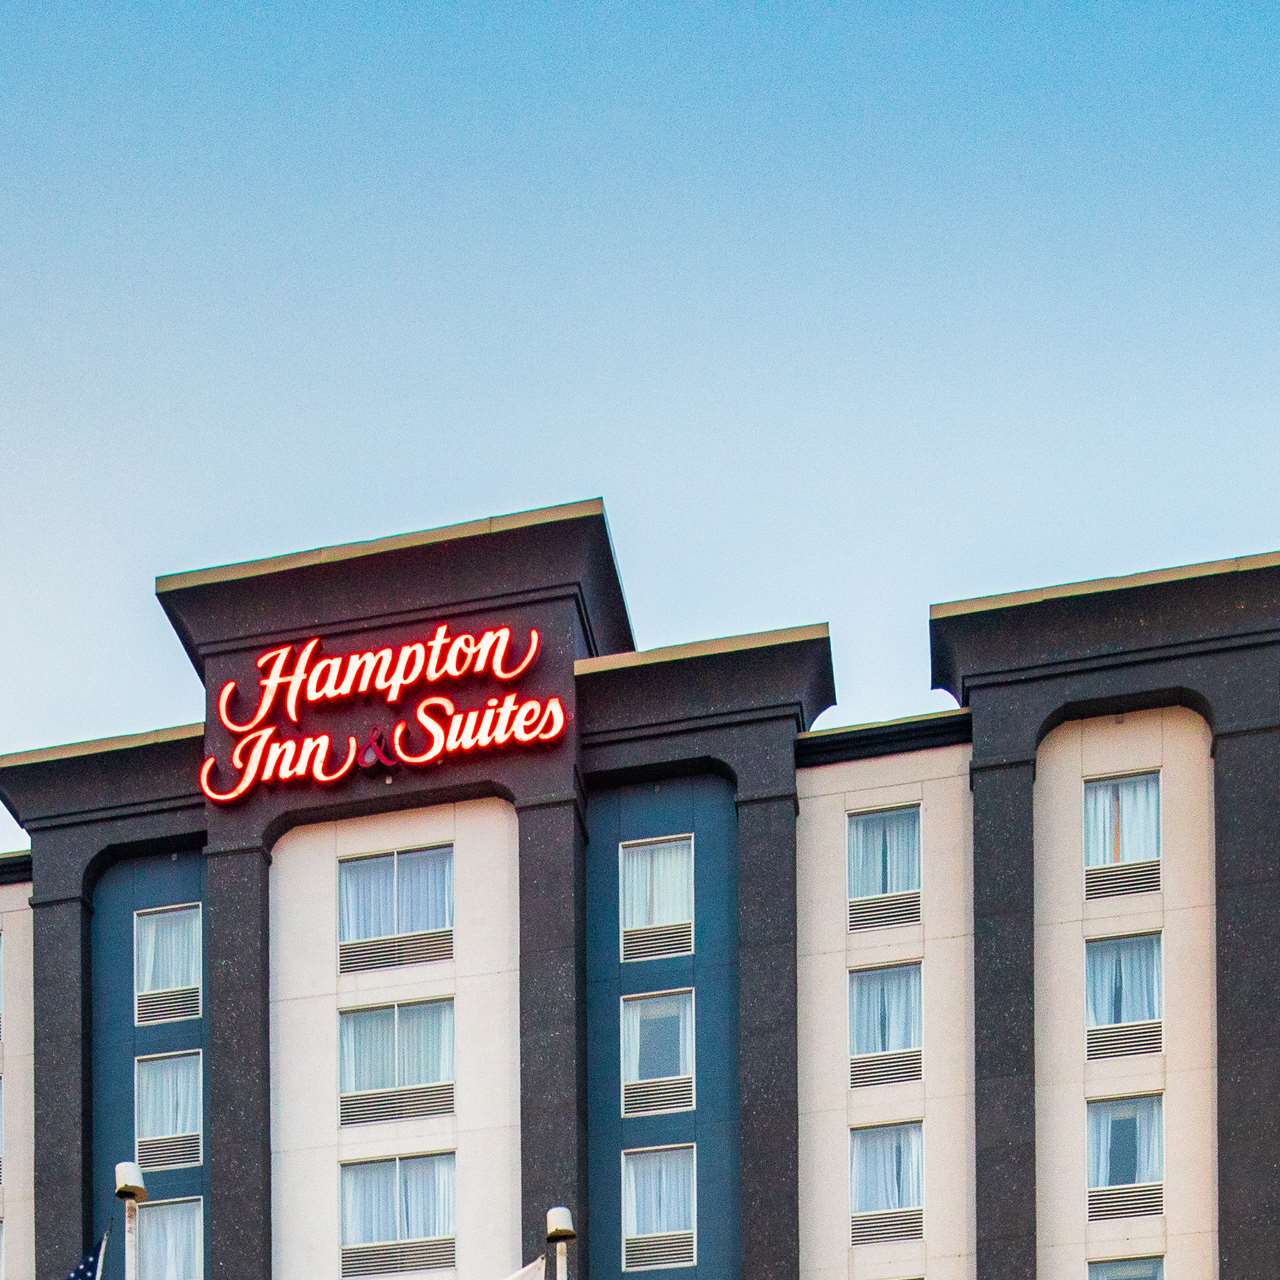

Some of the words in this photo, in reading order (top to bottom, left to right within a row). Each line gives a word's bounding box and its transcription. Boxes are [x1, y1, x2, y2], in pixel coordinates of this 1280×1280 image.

[219, 623, 540, 732] Hampton
[199, 725, 358, 802] Inn
[357, 726, 395, 768] &
[393, 692, 566, 764] Suites
